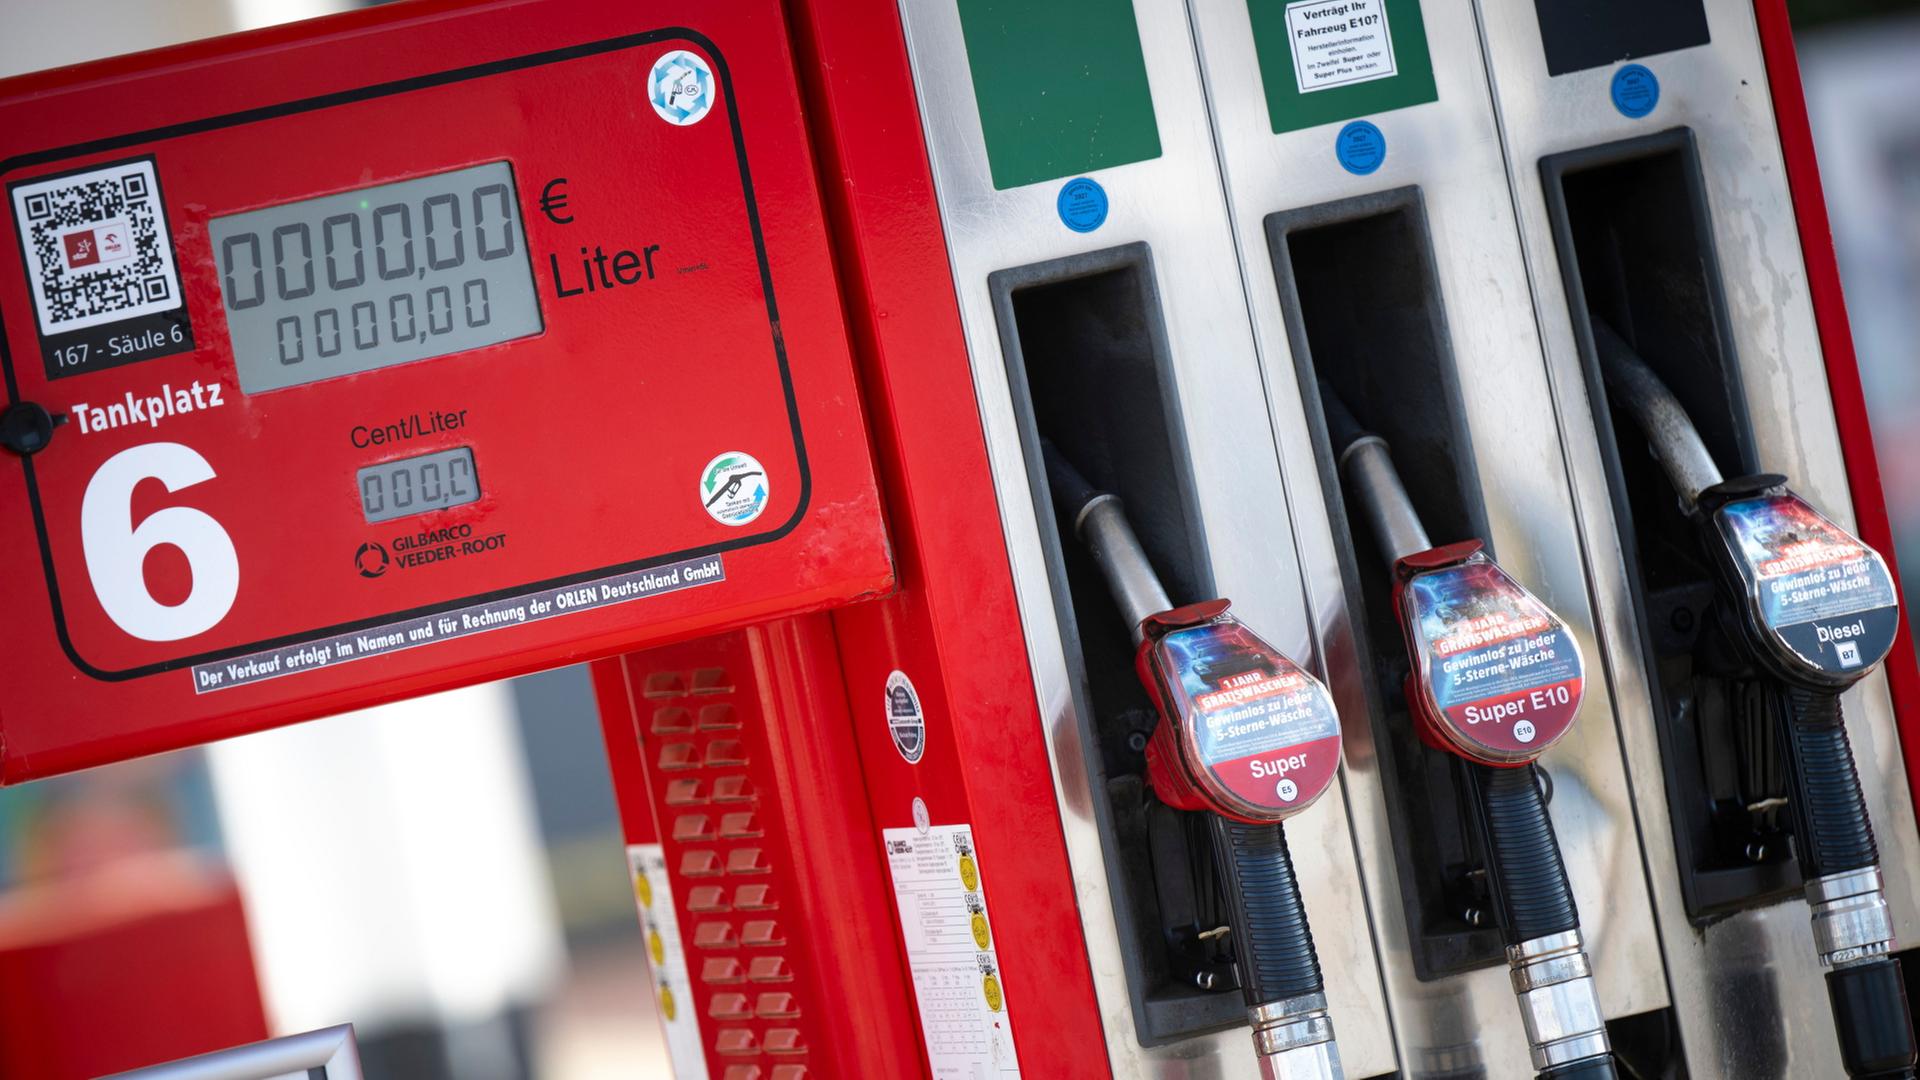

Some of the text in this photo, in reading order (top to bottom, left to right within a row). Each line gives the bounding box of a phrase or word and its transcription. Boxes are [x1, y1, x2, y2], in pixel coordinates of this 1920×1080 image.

[1303, 2, 1367, 20] Verträgt Ihr
[1297, 14, 1378, 39] Fahrzeug E10?
[1314, 71, 1335, 80] Super
[1336, 67, 1352, 75] Plus
[1342, 54, 1364, 64] Super
[539, 178, 574, 225] €
[550, 243, 660, 298] Liter
[54, 344, 89, 367] 167
[110, 330, 165, 357] Säule
[170, 324, 184, 343] 6
[72, 380, 224, 434] Tankplatz
[351, 409, 468, 448] Cent/Liter
[81, 442, 239, 641] 6
[392, 524, 472, 551] GILBARCO
[395, 534, 507, 569] VEEDER-ROOT
[1771, 570, 1826, 594] Gewinnlos
[1827, 568, 1840, 580] zu
[1780, 574, 1871, 606] 5-Sterne-Wäsche
[200, 561, 721, 687] Der Verkauf erfolgt im Namen und für Rechnung der ORLEN Deutschland GmbH
[1816, 619, 1866, 643] Diesel
[1443, 634, 1556, 673] Gewinnlos zu jeder
[1453, 649, 1556, 686] 5-Sterne-Wäsche
[1841, 650, 1855, 660] B7
[1223, 672, 1263, 689] 1 JAHR
[1206, 704, 1265, 729] Gewinnlos
[1267, 701, 1281, 712] zu
[1464, 686, 1570, 725] Super E10
[1216, 706, 1313, 741] 5-Sterne-Wäsche
[1516, 726, 1533, 737] E10
[1250, 752, 1308, 778] Super
[1281, 785, 1293, 794] E5
